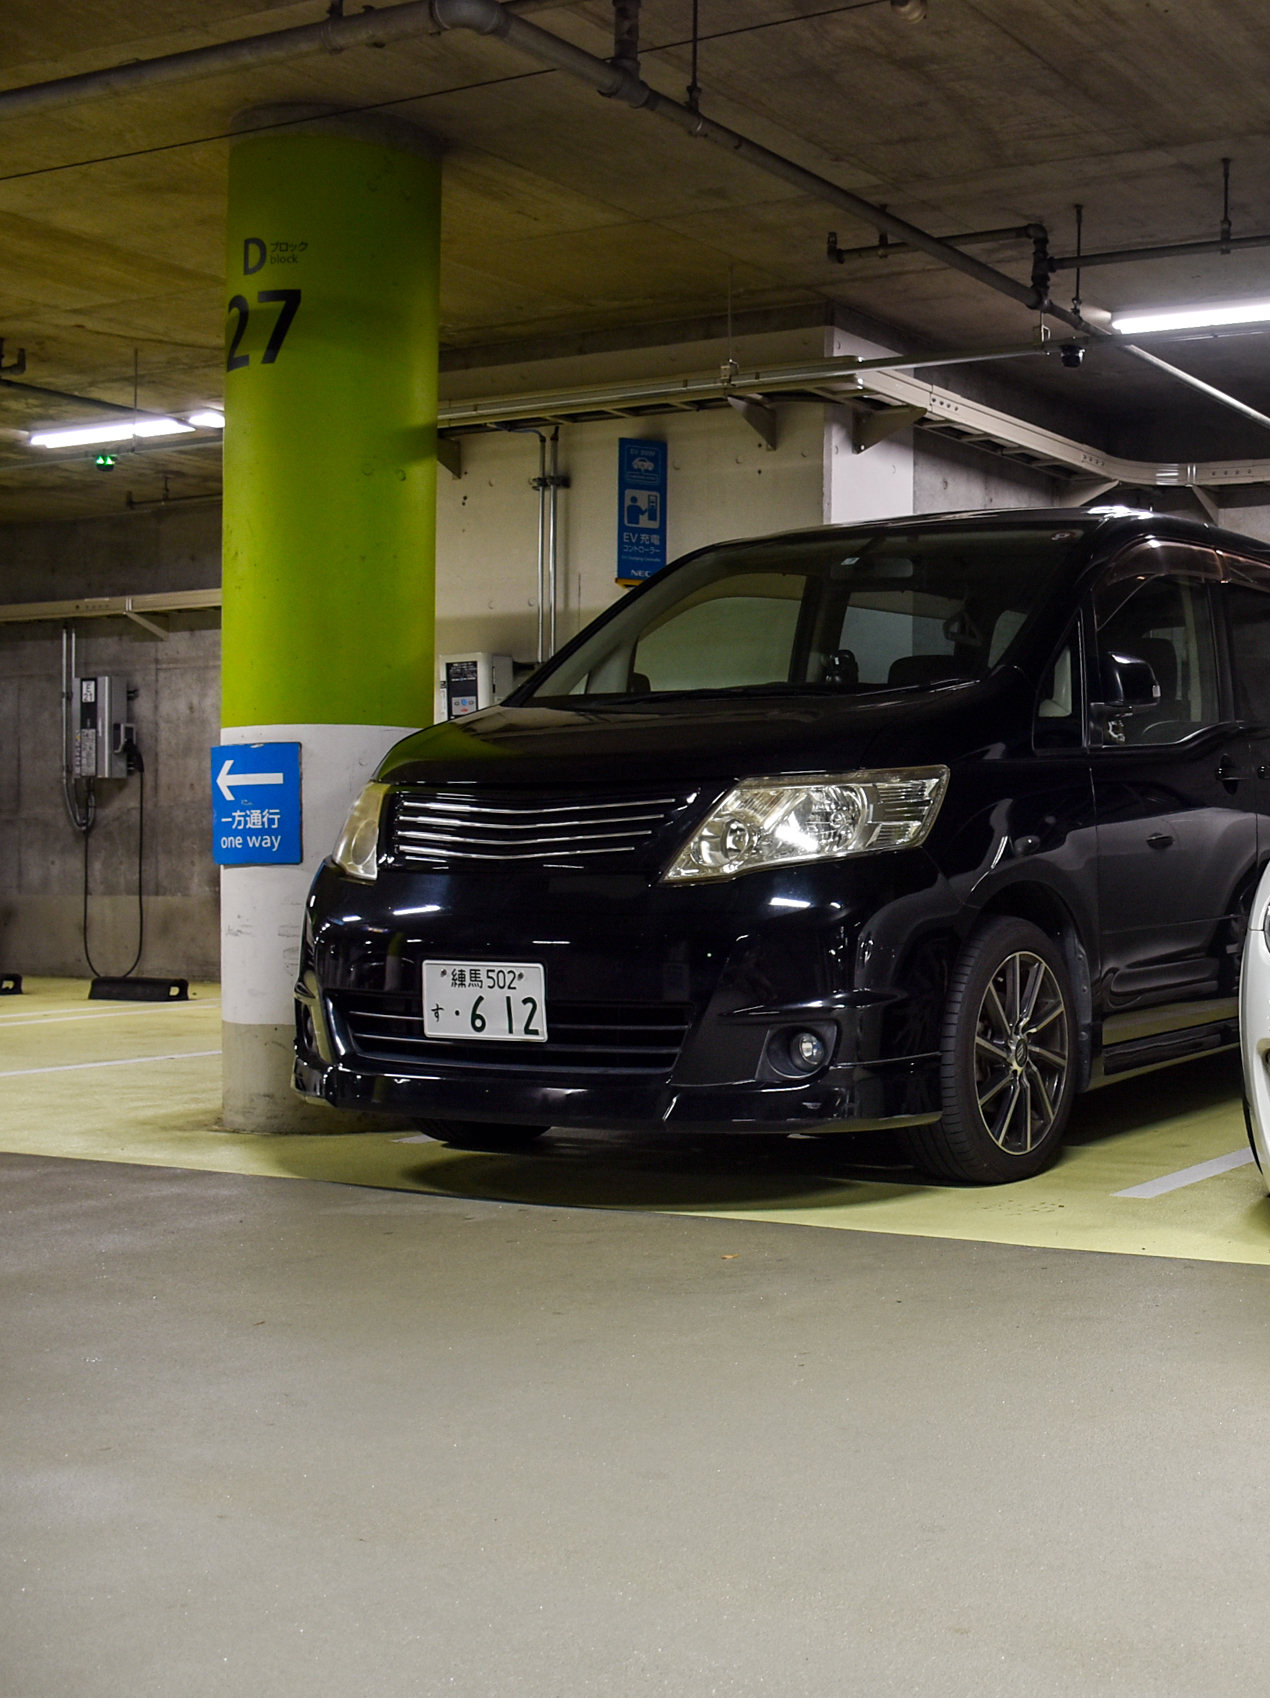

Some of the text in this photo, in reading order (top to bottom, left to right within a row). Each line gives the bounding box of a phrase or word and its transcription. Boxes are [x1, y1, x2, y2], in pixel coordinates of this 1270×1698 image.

[270, 242, 308, 253] ブロック
[243, 237, 267, 275] D
[270, 254, 299, 264] block
[226, 289, 302, 373] 27
[623, 532, 638, 543] EV
[631, 569, 652, 578] NEC
[86, 683, 91, 693] E
[221, 808, 281, 829] 一方通行
[220, 835, 281, 852] one way
[431, 1003, 445, 1022] す
